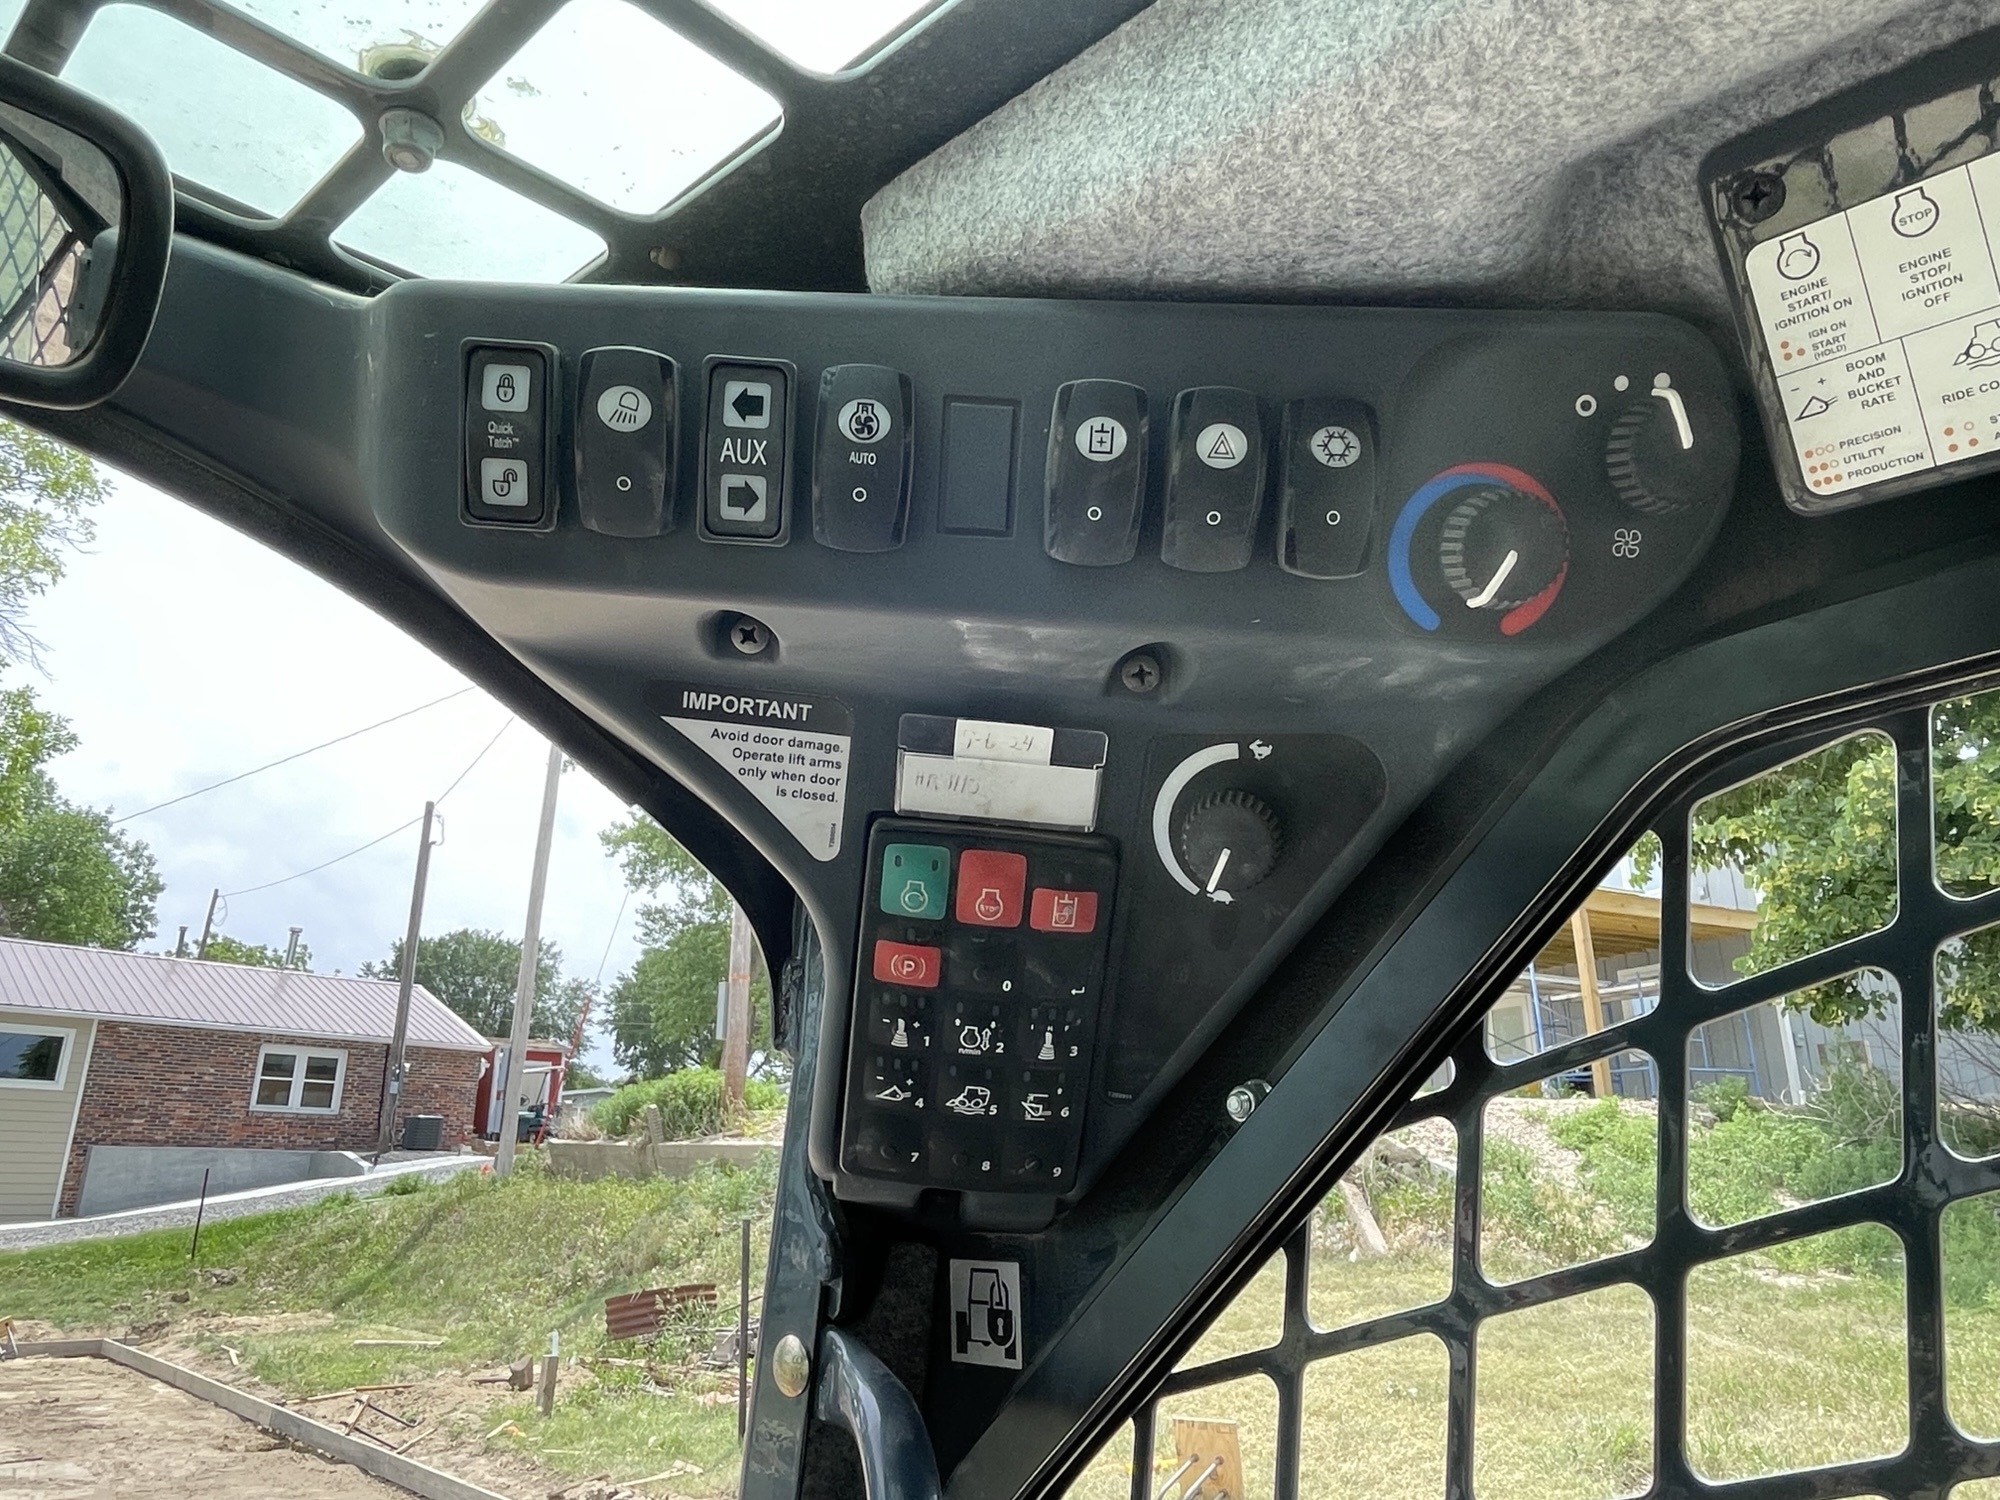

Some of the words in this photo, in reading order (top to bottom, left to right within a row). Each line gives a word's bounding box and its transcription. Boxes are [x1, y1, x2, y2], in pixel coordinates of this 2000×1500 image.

[1899, 208, 1932, 226] STOP
[1898, 247, 1952, 273] ENGINE
[1910, 262, 1951, 284] STOP/
[1780, 277, 1829, 301] ENGINE
[1901, 273, 1963, 302] IGNITION
[1787, 289, 1831, 312] START/
[1924, 291, 1951, 308] OFF
[1774, 304, 1830, 331] IGNITION
[1833, 297, 1853, 311] ON
[1808, 326, 1828, 339] IGN
[1830, 320, 1847, 332] ON
[1811, 333, 1847, 351] START
[1813, 344, 1847, 361] (HOLD)
[1845, 352, 1887, 372] BOOM
[1857, 367, 1885, 384] AND
[1847, 375, 1902, 400] BUCKET
[1941, 386, 1975, 405] RIDE
[1861, 392, 1897, 410] RATE
[488, 421, 514, 435] Quick
[1839, 425, 1902, 449] PRECISION
[720, 437, 767, 466] AUX
[849, 451, 877, 466] AUTO
[1843, 446, 1886, 464] UTILITY
[1847, 452, 1925, 479] PRODUCTION
[682, 691, 812, 721] IMPORTANT
[710, 728, 749, 742] Avoid
[753, 733, 784, 747] door
[787, 736, 844, 754] damage.
[732, 747, 785, 764] Operate
[788, 753, 805, 766] lift
[809, 757, 842, 770] arms
[738, 766, 767, 780] only
[770, 769, 806, 783] when
[810, 772, 841, 786] door
[776, 785, 787, 797] is
[791, 788, 838, 803] closed.
[903, 960, 915, 976] P
[923, 1036, 930, 1047] 1
[995, 1042, 1004, 1053] 2
[1069, 1045, 1078, 1057] 3
[915, 1098, 924, 1108] 4
[989, 1105, 998, 1115] 5
[1060, 1107, 1070, 1117] 6
[911, 1152, 919, 1162] 7
[981, 1161, 991, 1171] 8
[1053, 1167, 1062, 1177] 9
